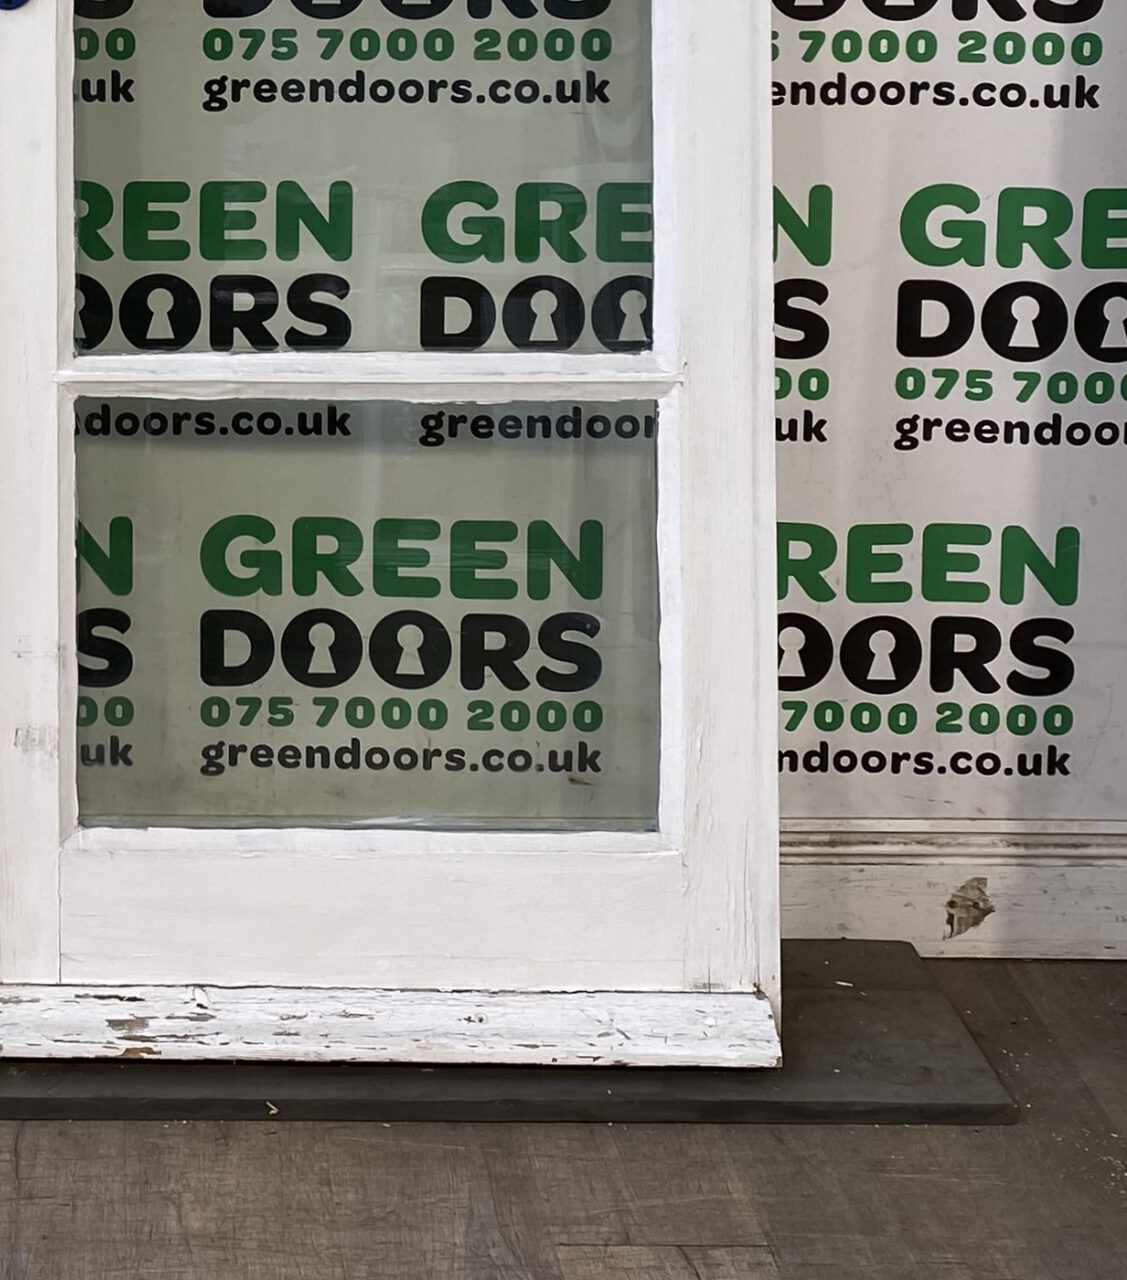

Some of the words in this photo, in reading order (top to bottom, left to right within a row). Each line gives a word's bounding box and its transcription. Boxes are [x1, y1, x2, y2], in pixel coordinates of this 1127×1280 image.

[202, 28, 298, 61] 075
[317, 28, 454, 61] 7000
[473, 29, 613, 61] 2000
[799, 29, 938, 64] 7000
[957, 31, 1103, 66] 2000
[203, 70, 611, 112] greendoors.co.uk
[421, 180, 653, 264] GRE
[900, 183, 1127, 270] GRE
[420, 275, 653, 352] DOO
[894, 368, 993, 402] 075
[1014, 371, 1127, 404] 700
[894, 411, 1127, 452] greendoor
[200, 514, 603, 600] GREEN
[776, 522, 1080, 606] REEN
[200, 608, 602, 694] DOORS
[778, 615, 1074, 696] OORS
[200, 696, 294, 729] 075
[313, 697, 448, 731] 7000
[467, 700, 603, 732] 2000
[784, 701, 917, 735] 7000
[936, 702, 1073, 736] 2000
[200, 738, 602, 776] greendoors.co.uk
